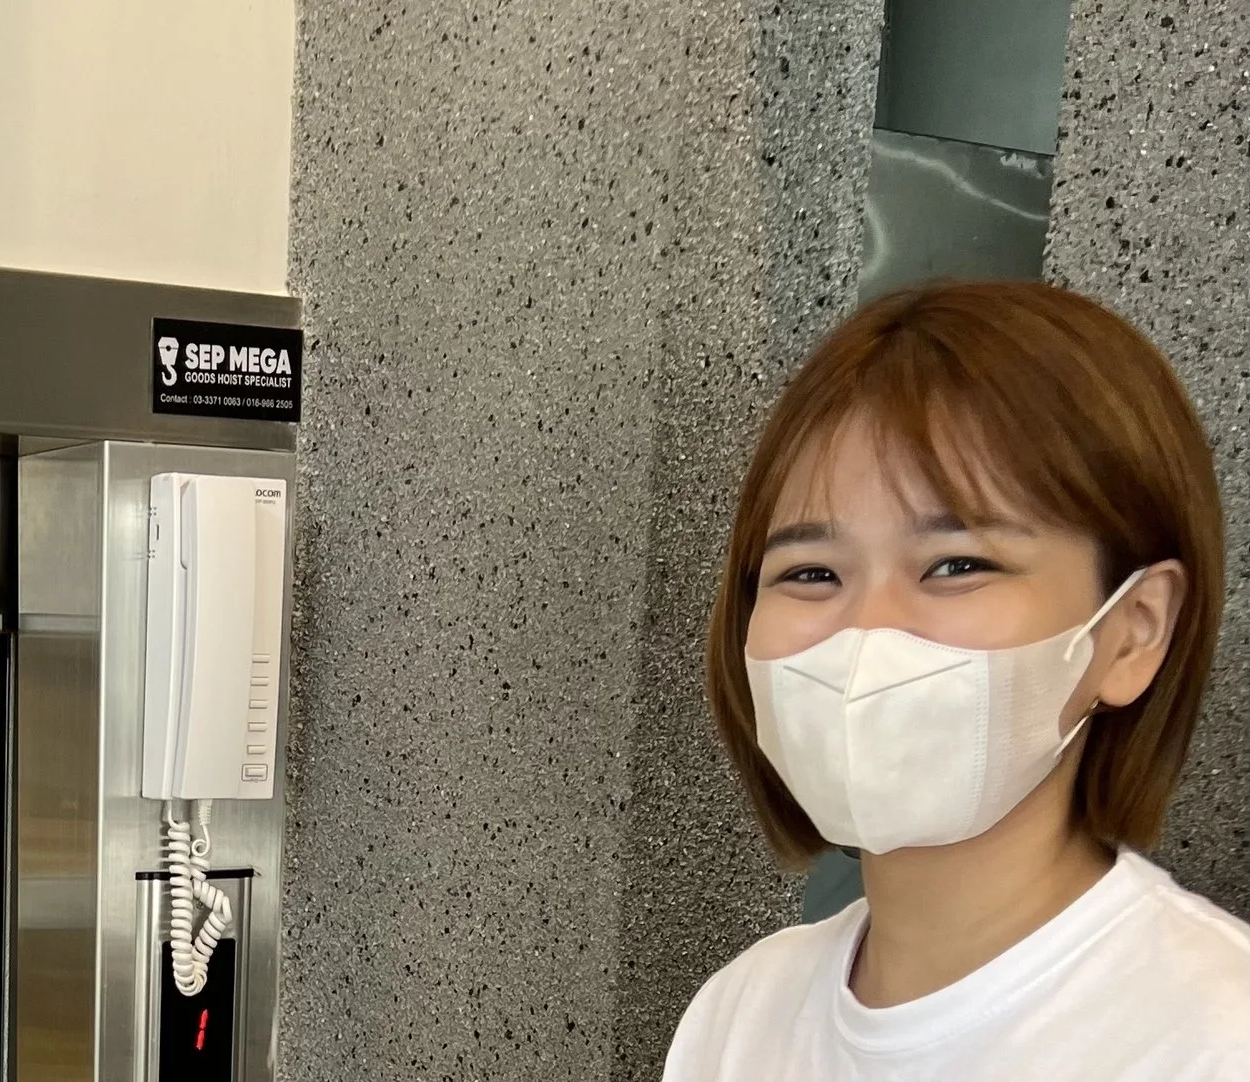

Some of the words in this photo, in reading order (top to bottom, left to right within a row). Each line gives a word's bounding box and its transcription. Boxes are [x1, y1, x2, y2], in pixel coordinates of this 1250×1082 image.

[185, 342, 225, 370] SEP
[229, 345, 292, 375] MEGA
[184, 371, 216, 384] GOODS
[217, 373, 243, 386] HOIST
[244, 375, 292, 388] SPECIALIST
[160, 393, 188, 404] Contact
[196, 1008, 208, 1050] 1
